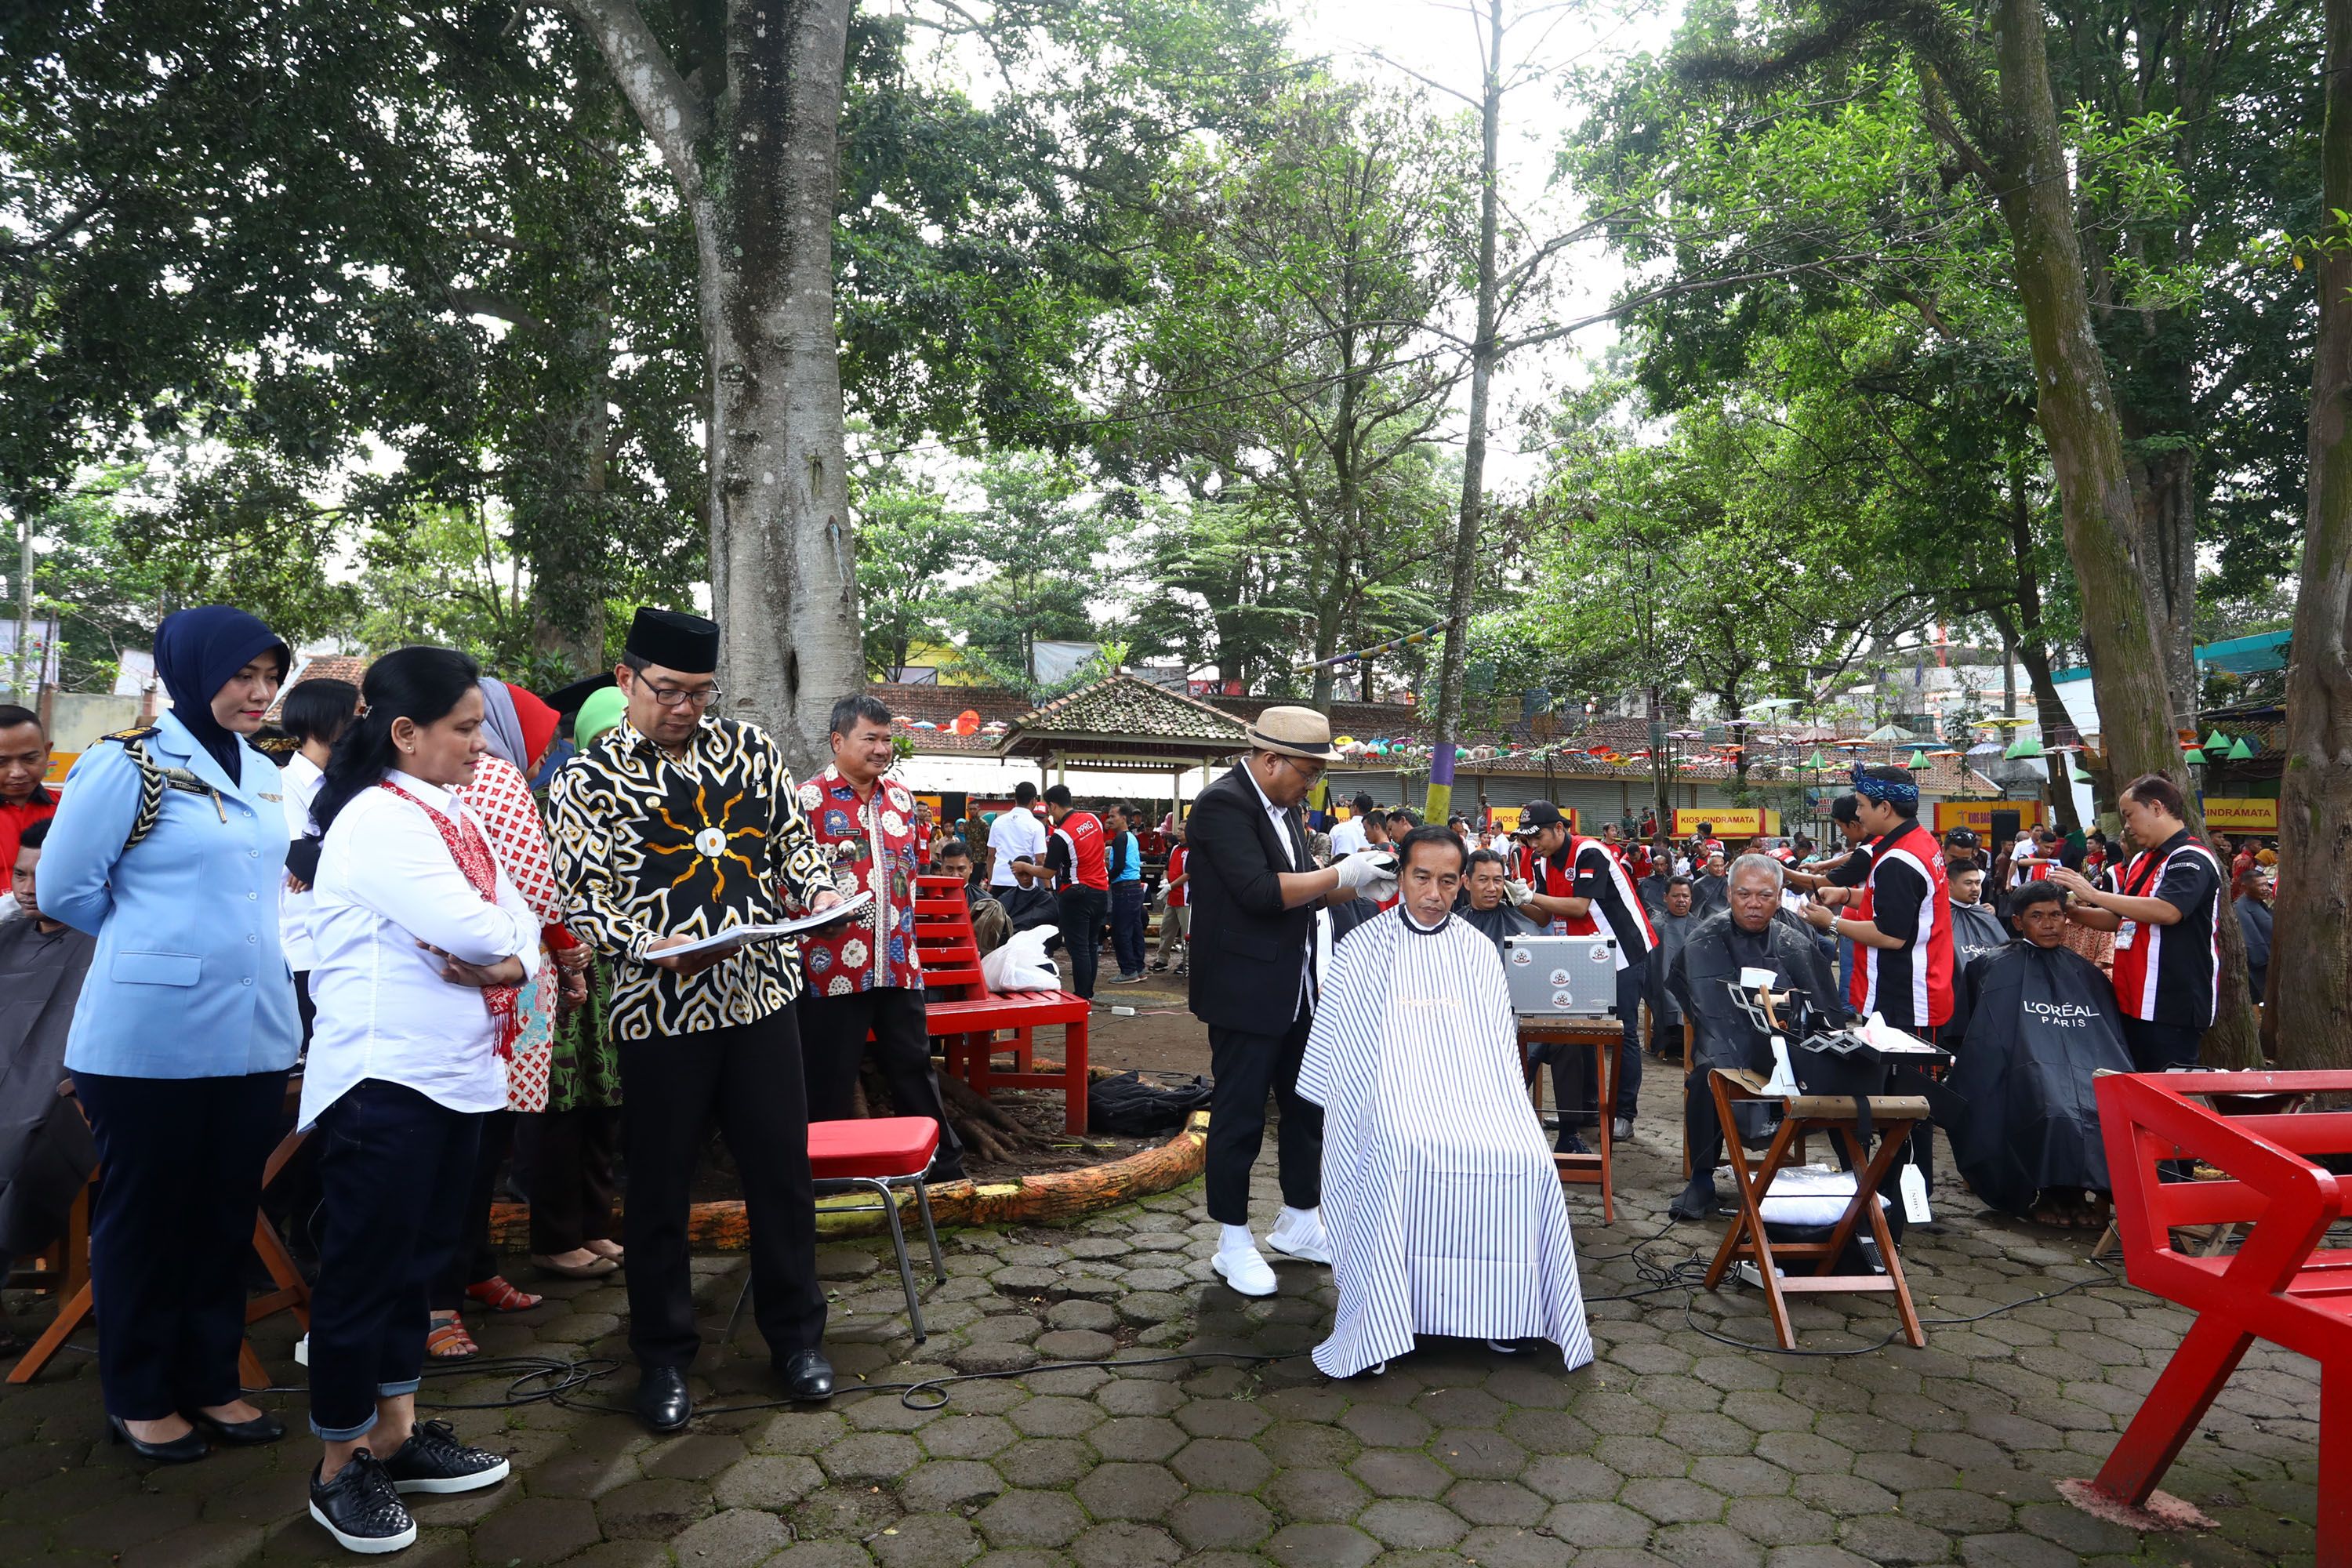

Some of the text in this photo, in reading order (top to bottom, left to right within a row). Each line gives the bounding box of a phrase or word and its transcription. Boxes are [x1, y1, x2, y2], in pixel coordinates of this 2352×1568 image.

[1076, 820, 1094, 836] PPRG
[2023, 1000, 2100, 1017] L'ORÉAL
[2041, 1016, 2086, 1028] PARIS
